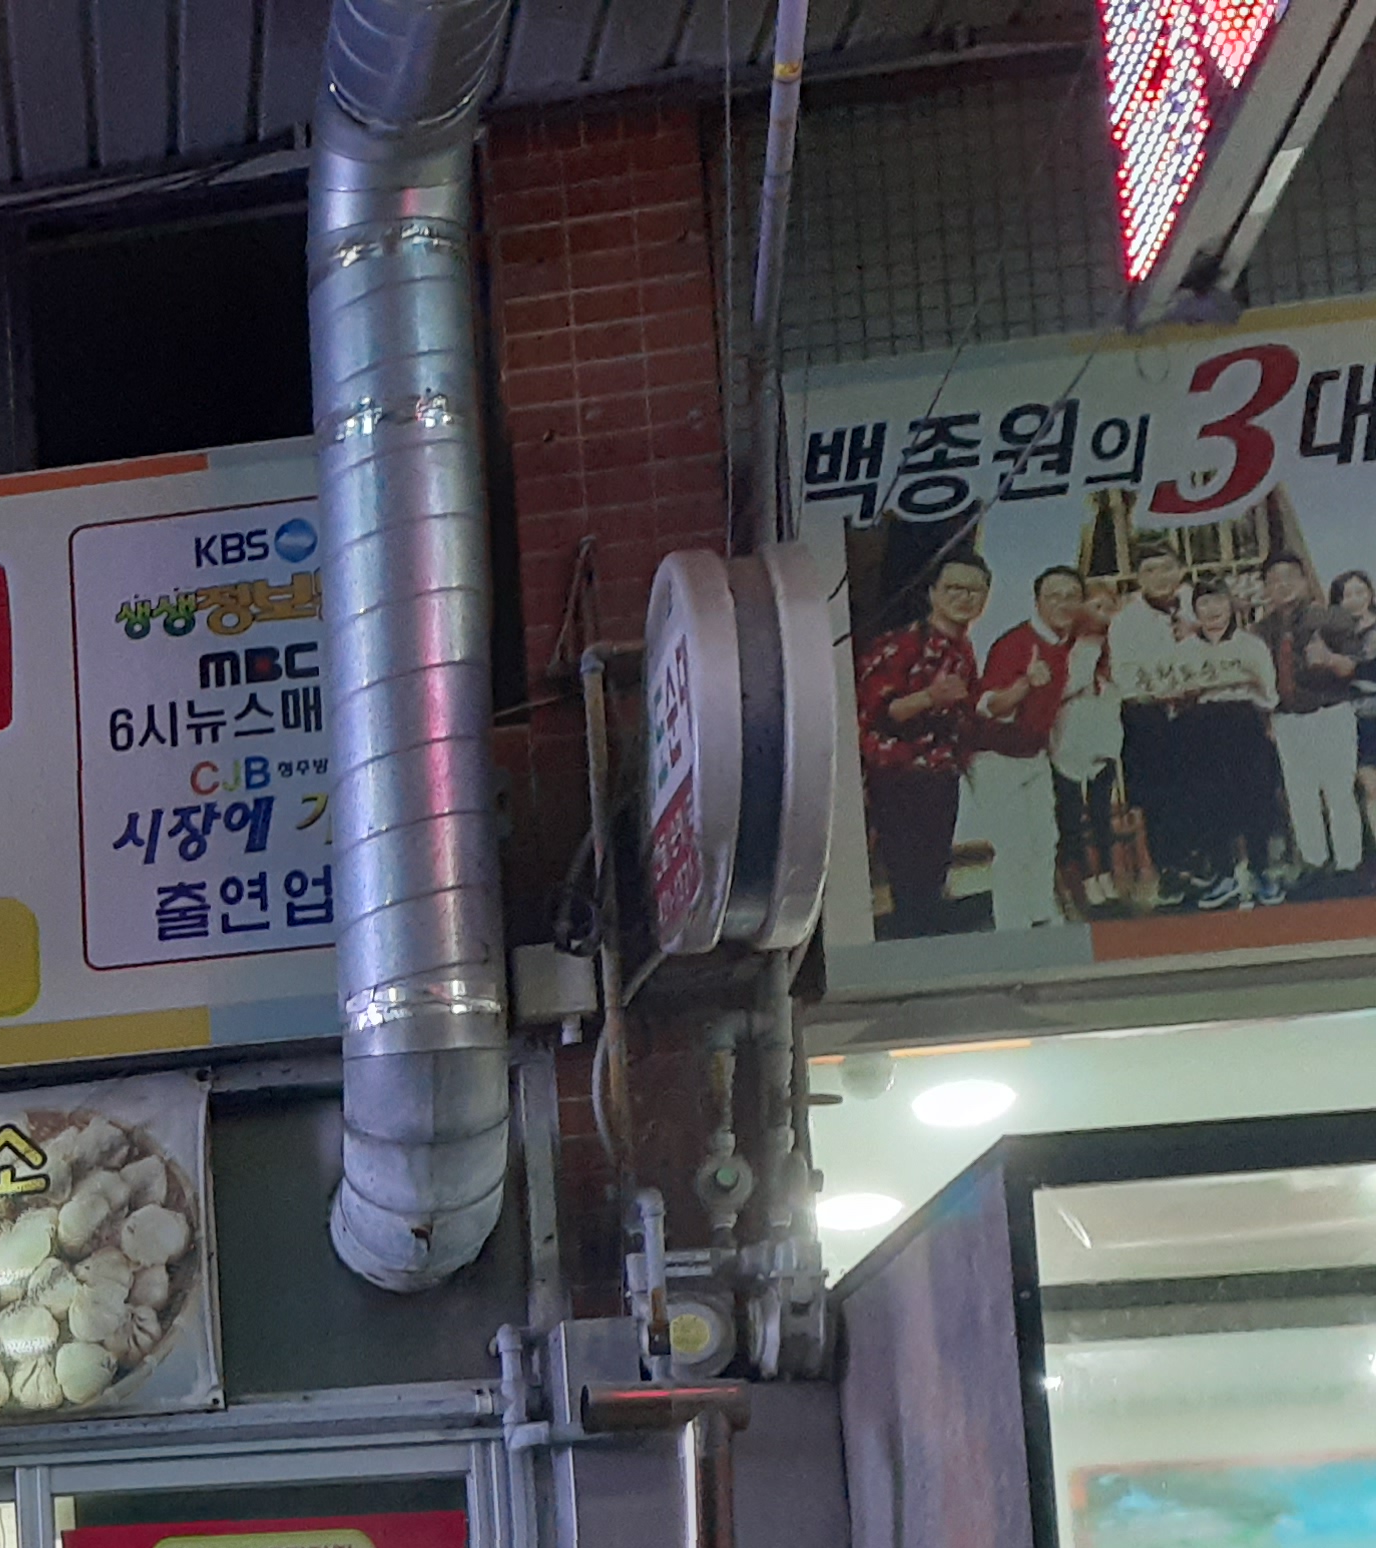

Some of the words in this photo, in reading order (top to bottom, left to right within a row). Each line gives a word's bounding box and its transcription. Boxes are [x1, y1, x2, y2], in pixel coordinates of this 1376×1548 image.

[802, 400, 1151, 531] 백종원의
[194, 529, 271, 569] KBS
[116, 566, 324, 640] 생생정보
[199, 641, 321, 689] MBC
[190, 755, 271, 796] CJB
[112, 795, 276, 866] 시장에
